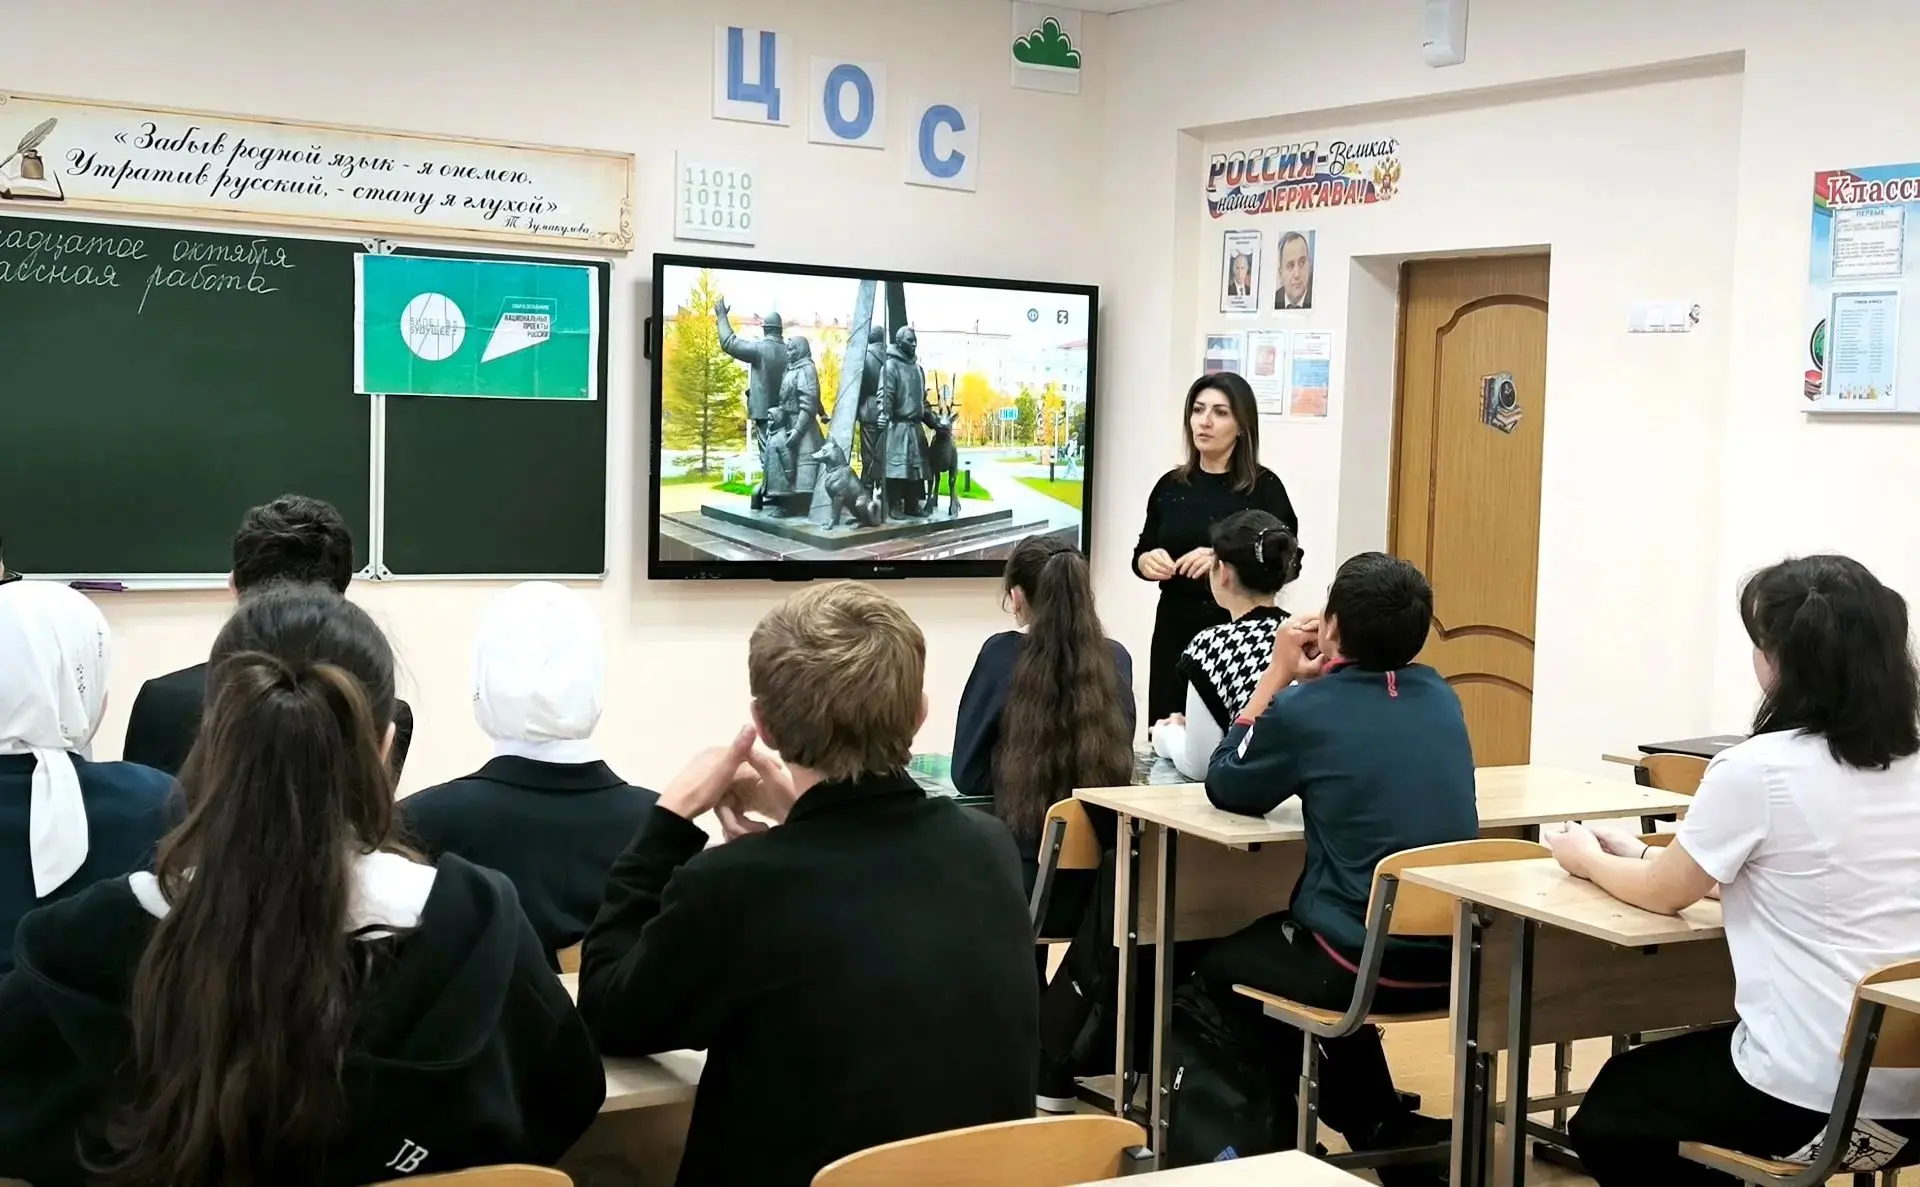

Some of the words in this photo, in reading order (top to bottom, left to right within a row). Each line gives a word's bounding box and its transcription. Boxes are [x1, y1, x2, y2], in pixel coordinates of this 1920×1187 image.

[226, 138, 323, 171] родной
[328, 152, 395, 179] язык
[416, 162, 434, 174] я
[1329, 138, 1395, 176] Великая
[65, 147, 210, 190] Утратив
[209, 162, 328, 199] русский,
[352, 184, 435, 215] стану
[440, 192, 457, 207] я
[685, 167, 752, 190] 11010
[1216, 194, 1260, 213] наша
[1260, 179, 1368, 213] ДЕРЖАВА!
[684, 187, 751, 210] 10110
[684, 206, 751, 229] 11010
[173, 239, 296, 278] октября
[138, 264, 279, 314] работа
